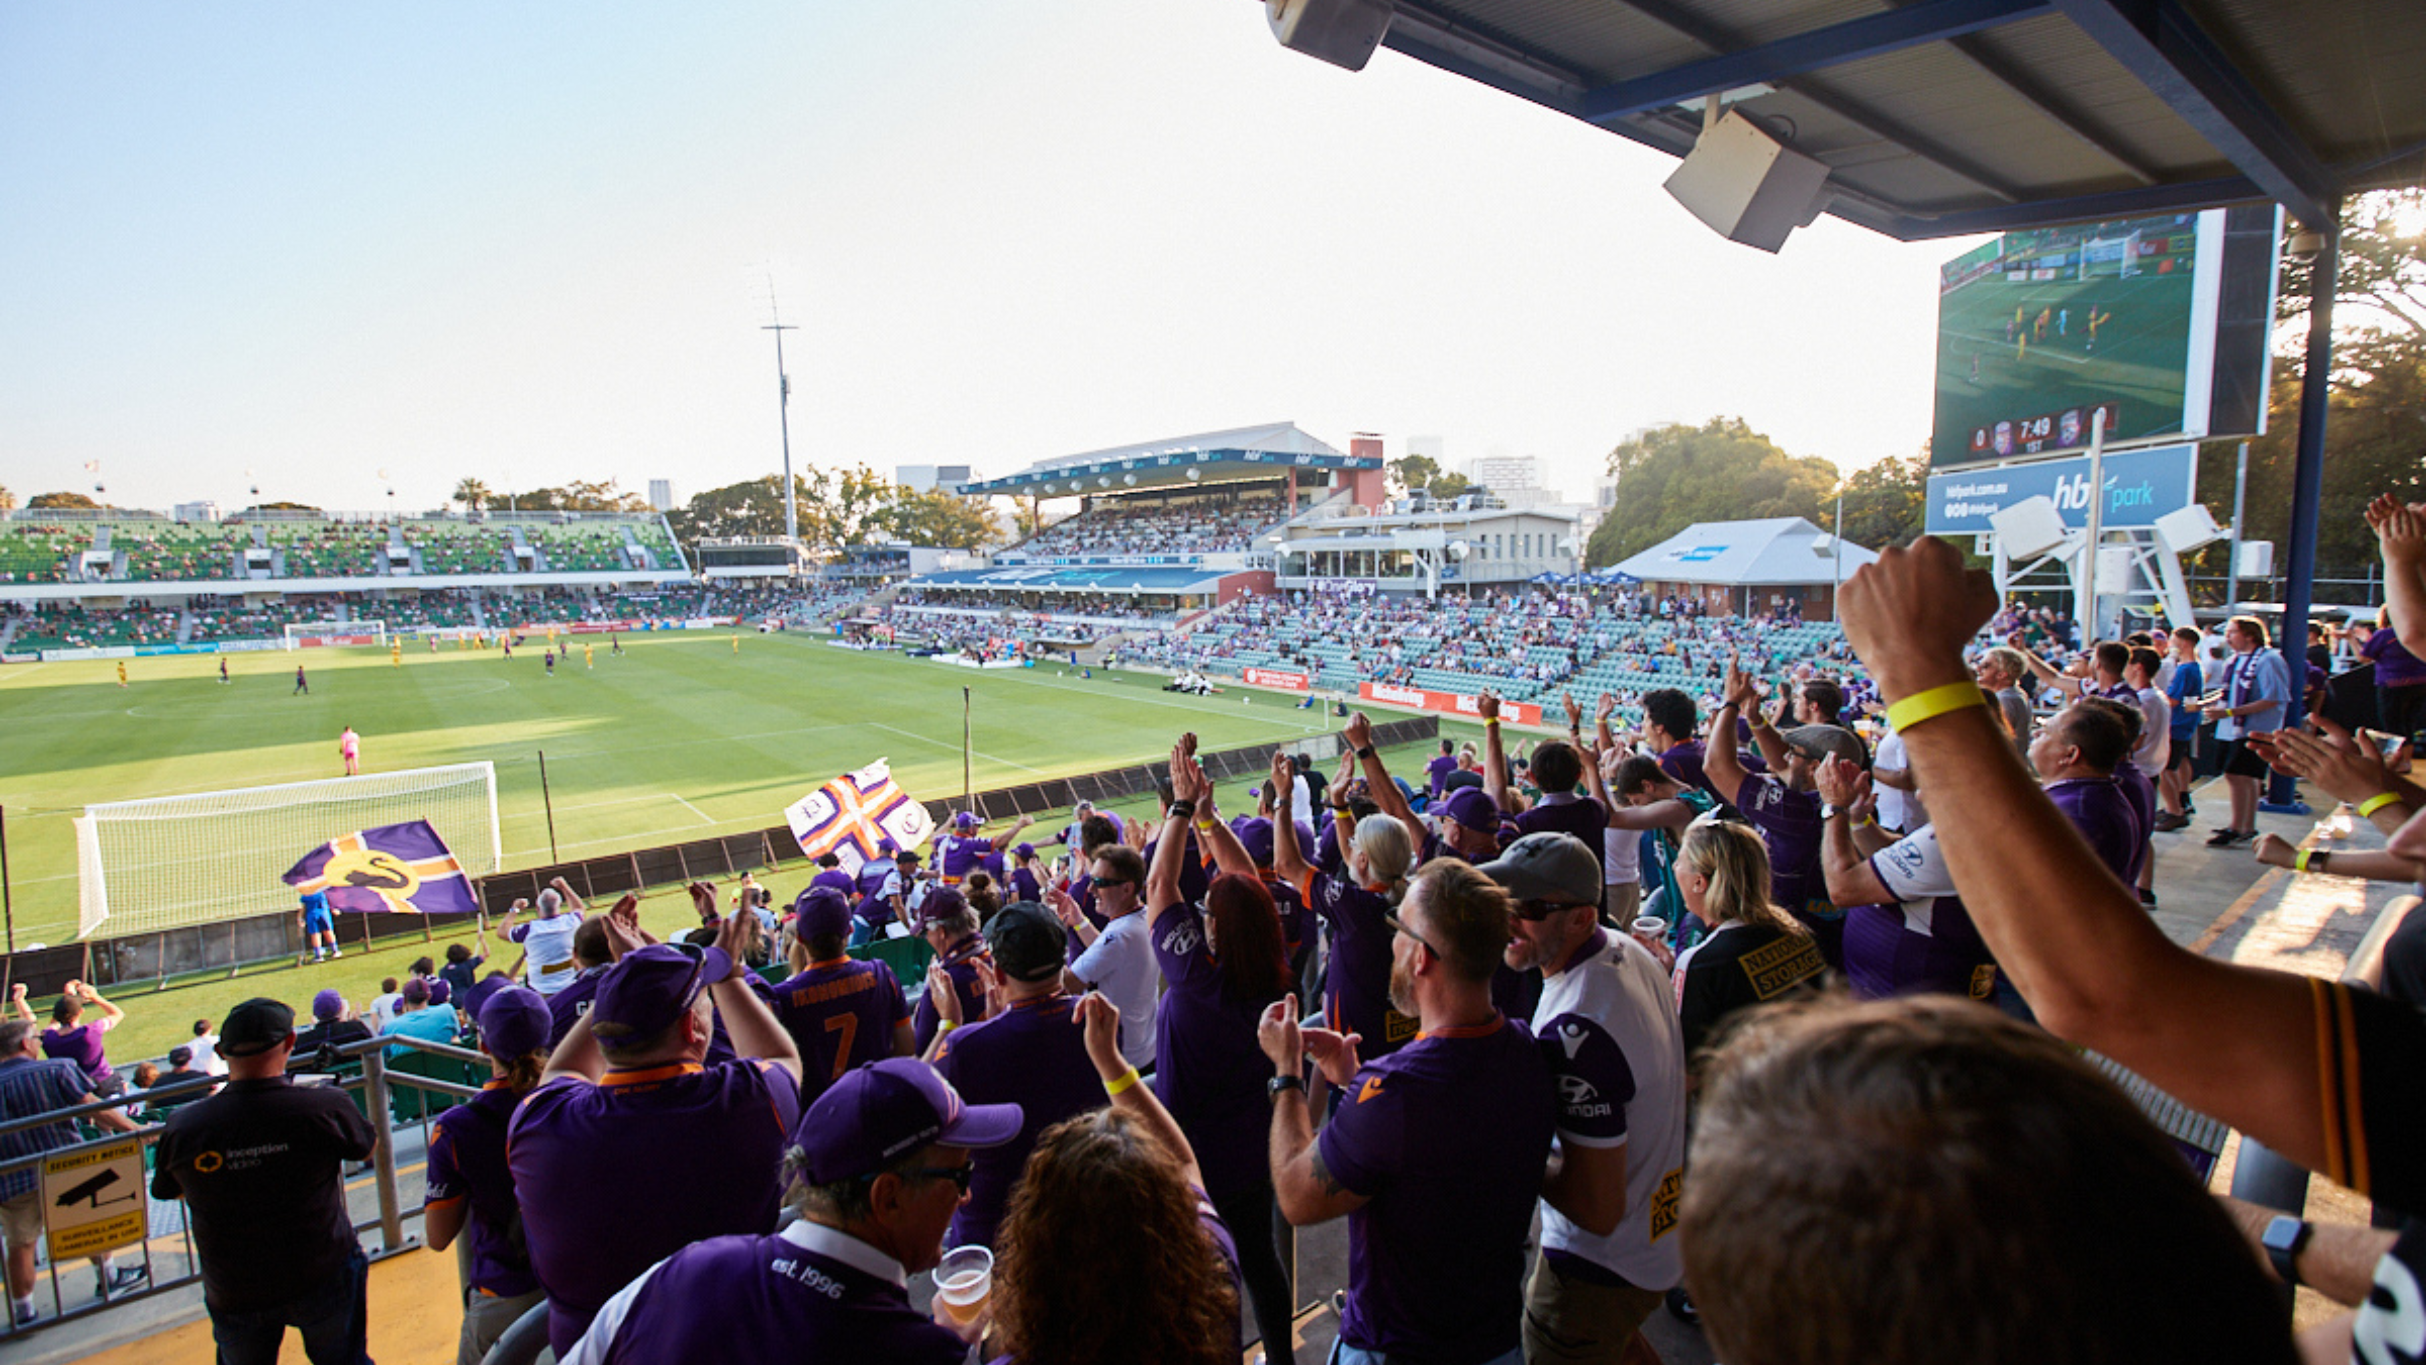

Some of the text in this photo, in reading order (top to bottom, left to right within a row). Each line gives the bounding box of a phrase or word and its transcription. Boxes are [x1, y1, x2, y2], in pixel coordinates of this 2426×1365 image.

[1975, 428, 1985, 447] 0
[2020, 416, 2051, 439] 7:49
[2112, 480, 2154, 514] park
[824, 1011, 858, 1080] 7
[50, 1144, 135, 1171] SECURITY NOTICE
[56, 1225, 140, 1253] CAMERAS IN USE
[62, 1218, 135, 1242] SURVEILLANCE
[771, 1257, 846, 1300] est 1996
